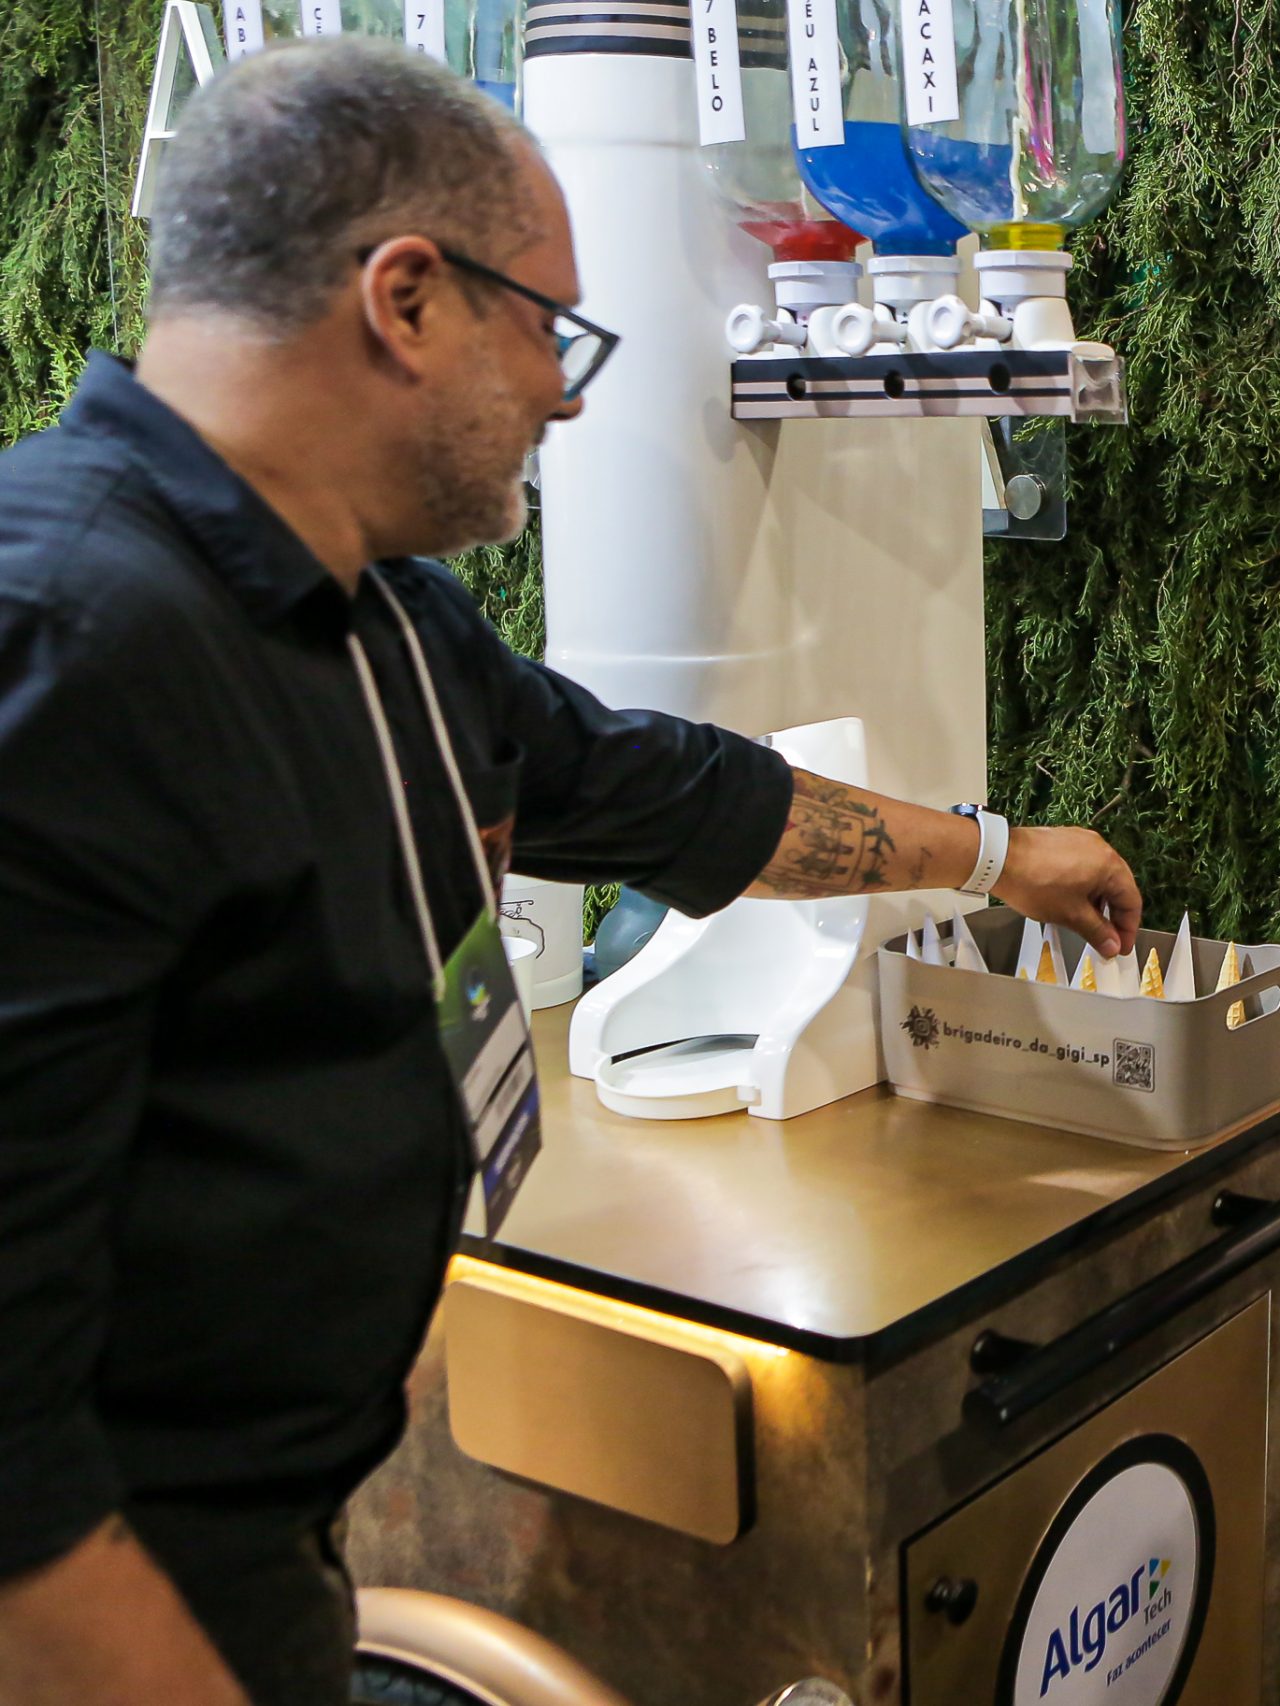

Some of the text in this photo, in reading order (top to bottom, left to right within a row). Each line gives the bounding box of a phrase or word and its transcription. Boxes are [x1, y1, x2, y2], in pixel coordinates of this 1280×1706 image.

[707, 27, 723, 112] BELO
[807, 57, 820, 132] AZUL
[1039, 1564, 1172, 1699] Algar Tech
[1106, 1618, 1172, 1688] Faz acontecer
